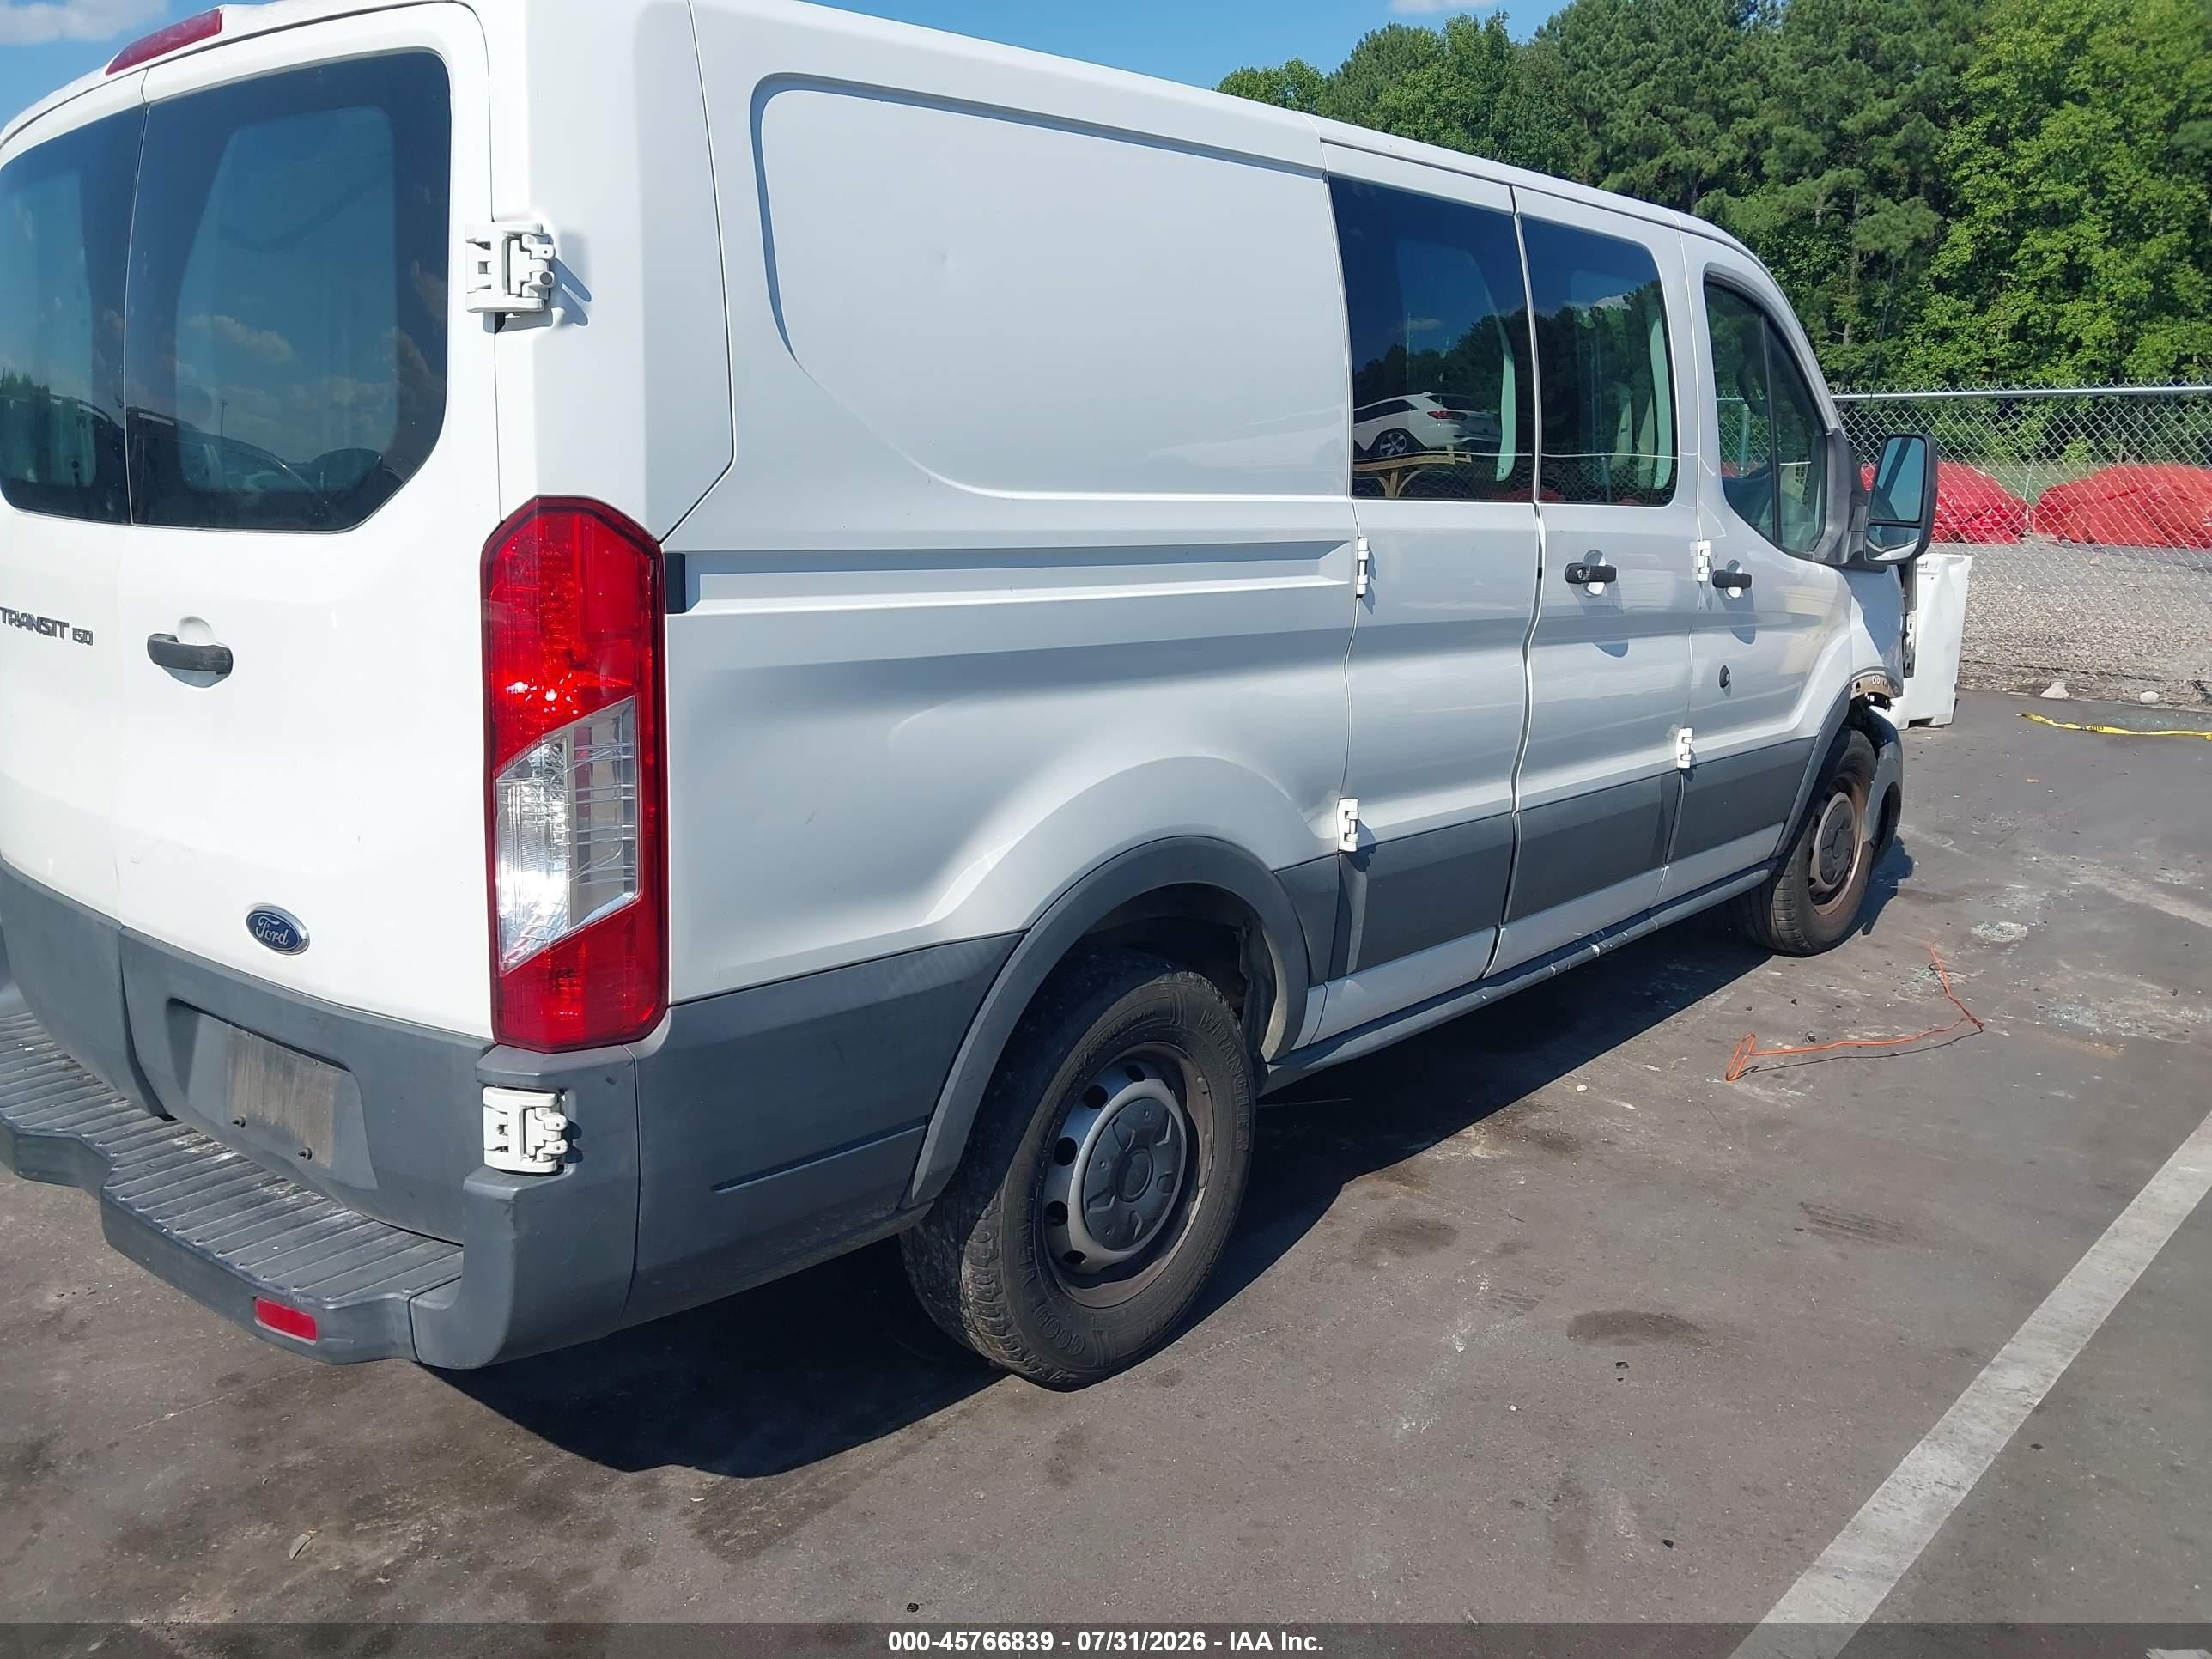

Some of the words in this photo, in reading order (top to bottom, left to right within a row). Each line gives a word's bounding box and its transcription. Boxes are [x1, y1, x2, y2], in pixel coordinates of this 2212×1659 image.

[0, 606, 70, 639] TRANSIT
[256, 915, 289, 945] Ford
[1198, 1009, 1251, 1154] WRANGLER
